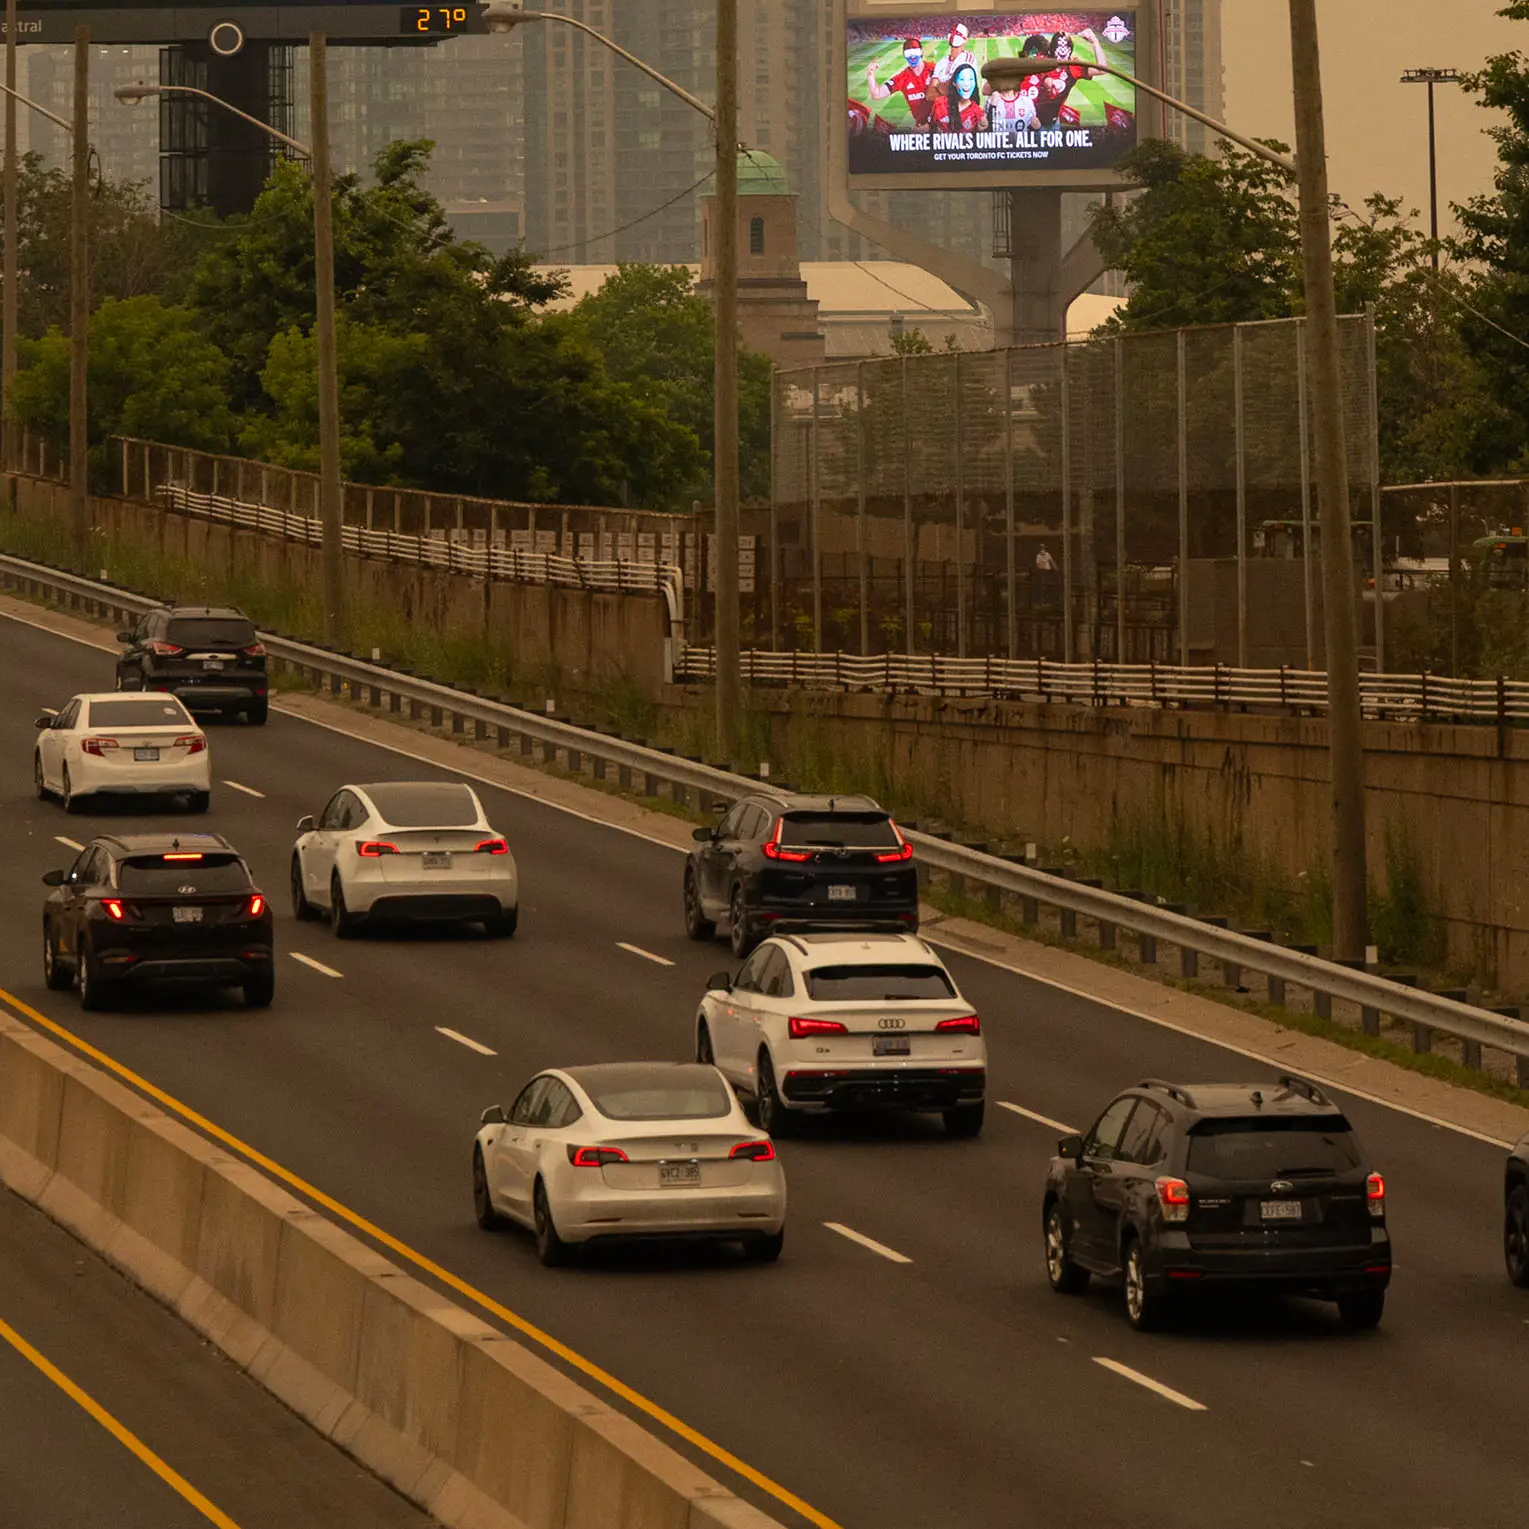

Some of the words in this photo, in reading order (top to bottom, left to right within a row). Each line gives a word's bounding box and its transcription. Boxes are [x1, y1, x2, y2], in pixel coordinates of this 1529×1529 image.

[1, 20, 42, 33] atral
[889, 134, 930, 151] WHERE
[933, 132, 973, 150] RIVALS
[976, 132, 1013, 149] UNITE.
[1016, 132, 1037, 148] ALL
[1040, 131, 1064, 148] FOR
[1066, 130, 1093, 147] ONE.
[934, 153, 947, 161] GET
[1006, 151, 1031, 159] TICKETS
